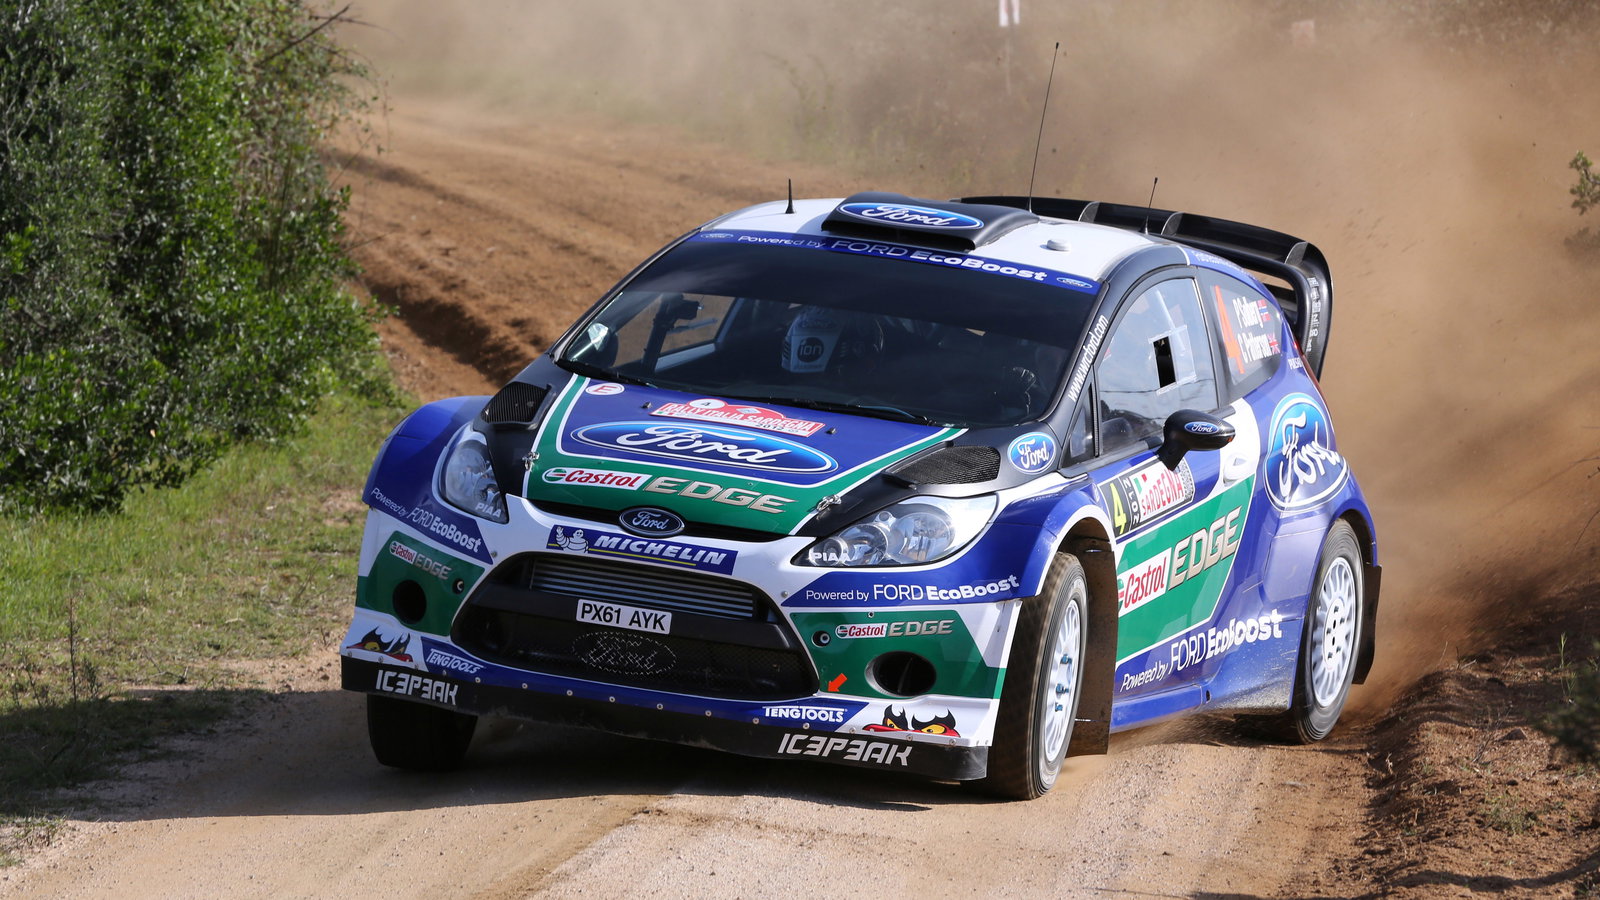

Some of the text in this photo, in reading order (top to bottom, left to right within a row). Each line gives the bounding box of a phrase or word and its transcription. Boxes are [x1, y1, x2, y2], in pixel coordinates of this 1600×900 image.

[860, 203, 959, 227] Ford
[738, 235, 1047, 281] Powered by FORD EcoBoost
[1067, 315, 1109, 402] www.wrcford.com
[593, 385, 617, 394] E
[663, 403, 817, 432] RALLY ITALIA SARDEGNA
[1191, 423, 1213, 433] Ford
[616, 426, 792, 463] Ford
[1018, 439, 1049, 469] Ford
[1279, 411, 1340, 498] Ford
[565, 470, 799, 514] Castrol EDGE
[1141, 469, 1185, 516] SARDEGNA
[371, 487, 482, 553] Powered by FORD EcoBoost
[475, 502, 502, 518] PIAA
[632, 511, 670, 530] Ford
[1109, 482, 1127, 535] 4
[395, 544, 452, 580] Castrol EDGE
[594, 535, 727, 566] MICHELIN
[810, 552, 850, 562] PIAA
[1124, 505, 1243, 609] Castrol EDGE
[806, 574, 1020, 601] Powered by FORD EcoBoost
[580, 603, 666, 631] PX61 AYK
[848, 619, 955, 637] Castrol EDGE
[1120, 608, 1283, 692] Powered by FORD EcoBoost
